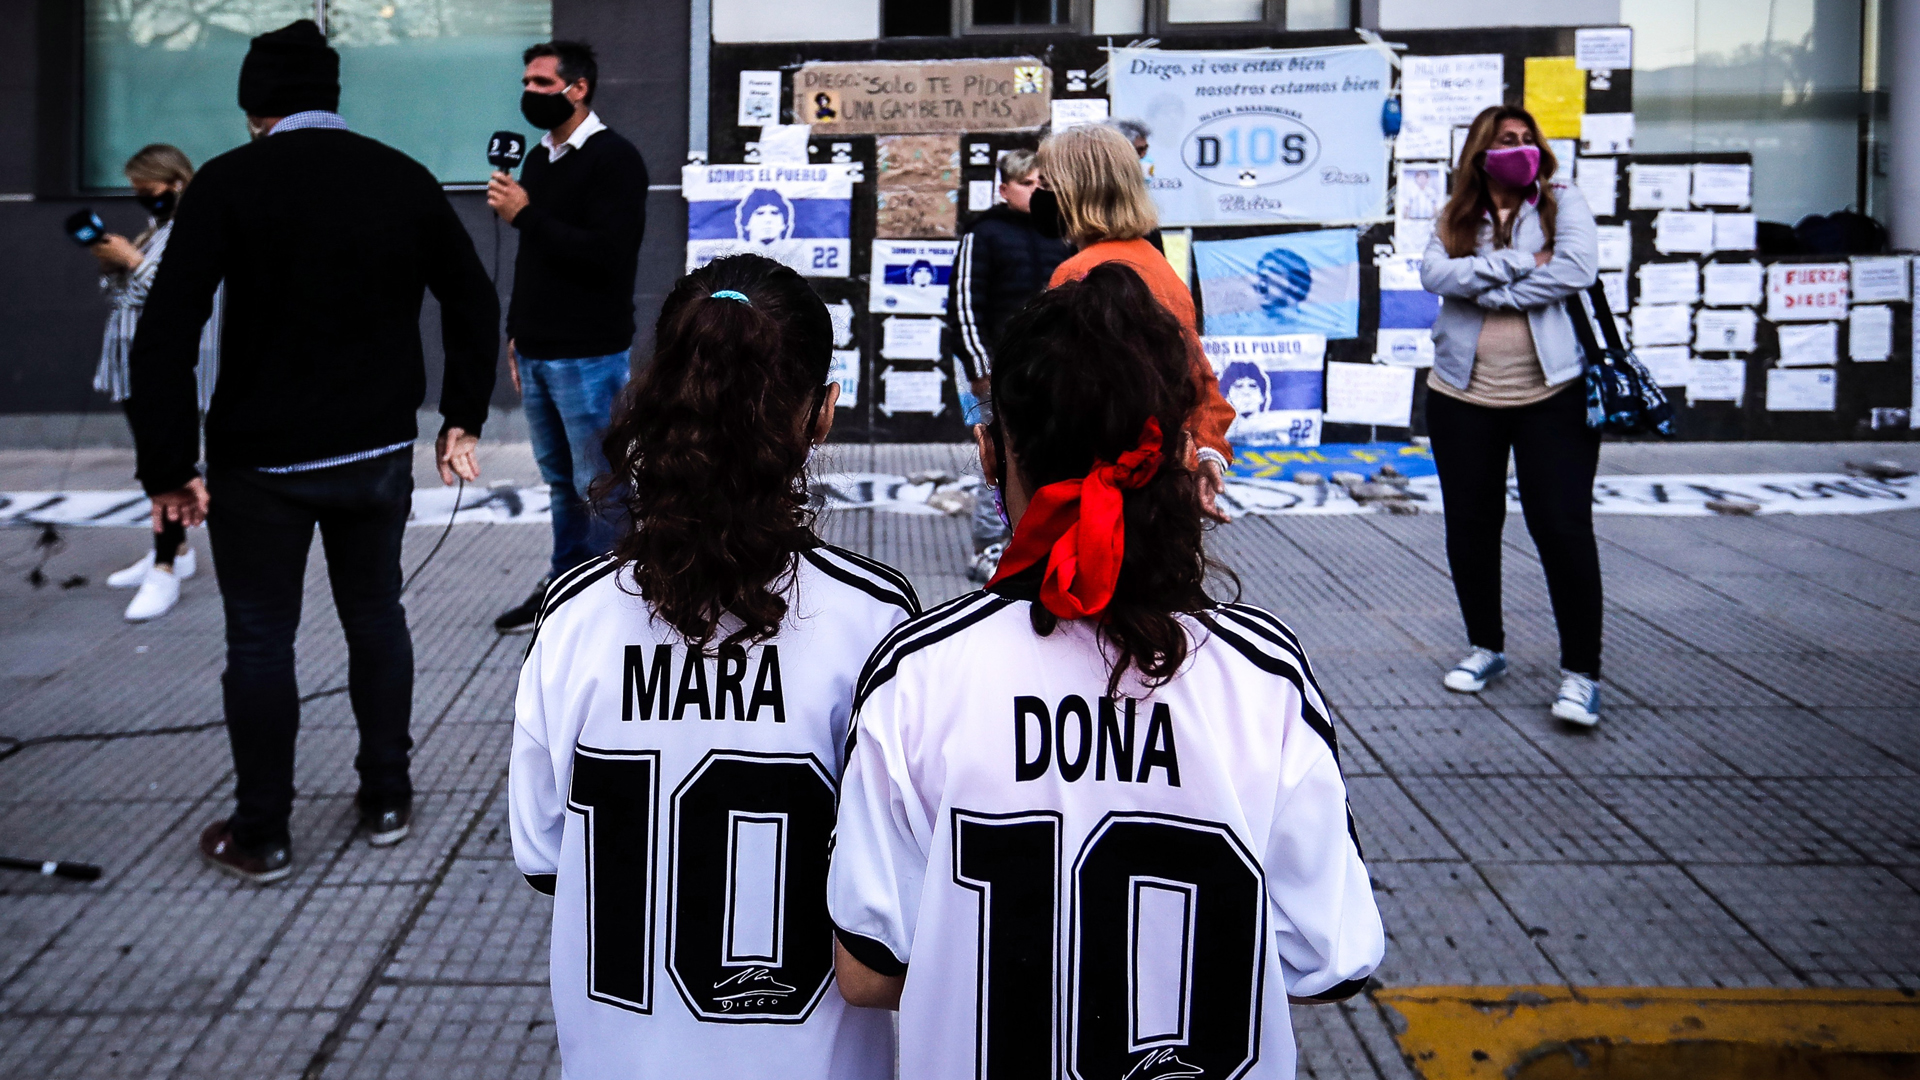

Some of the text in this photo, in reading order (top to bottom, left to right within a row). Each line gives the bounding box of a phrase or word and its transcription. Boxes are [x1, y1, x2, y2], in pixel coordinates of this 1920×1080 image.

[1130, 58, 1186, 80] Diego,
[1190, 60, 1205, 75] si
[1210, 62, 1238, 74] vos
[1287, 56, 1325, 73] bien
[925, 75, 952, 95] TE
[1195, 74, 1380, 98] nosotros estamos bien
[841, 100, 875, 121] UNA
[879, 100, 966, 120] GAMBETA
[707, 166, 828, 184] SOMOS EL PUEBLO
[812, 246, 839, 269] 22
[1251, 340, 1302, 354] PUEBLO
[1288, 419, 1314, 439] 22
[621, 645, 787, 724] MARA
[1013, 693, 1182, 787] DONA
[566, 741, 839, 1025] 10
[950, 808, 1267, 1080] 10
[720, 997, 778, 1012] DIEGO
